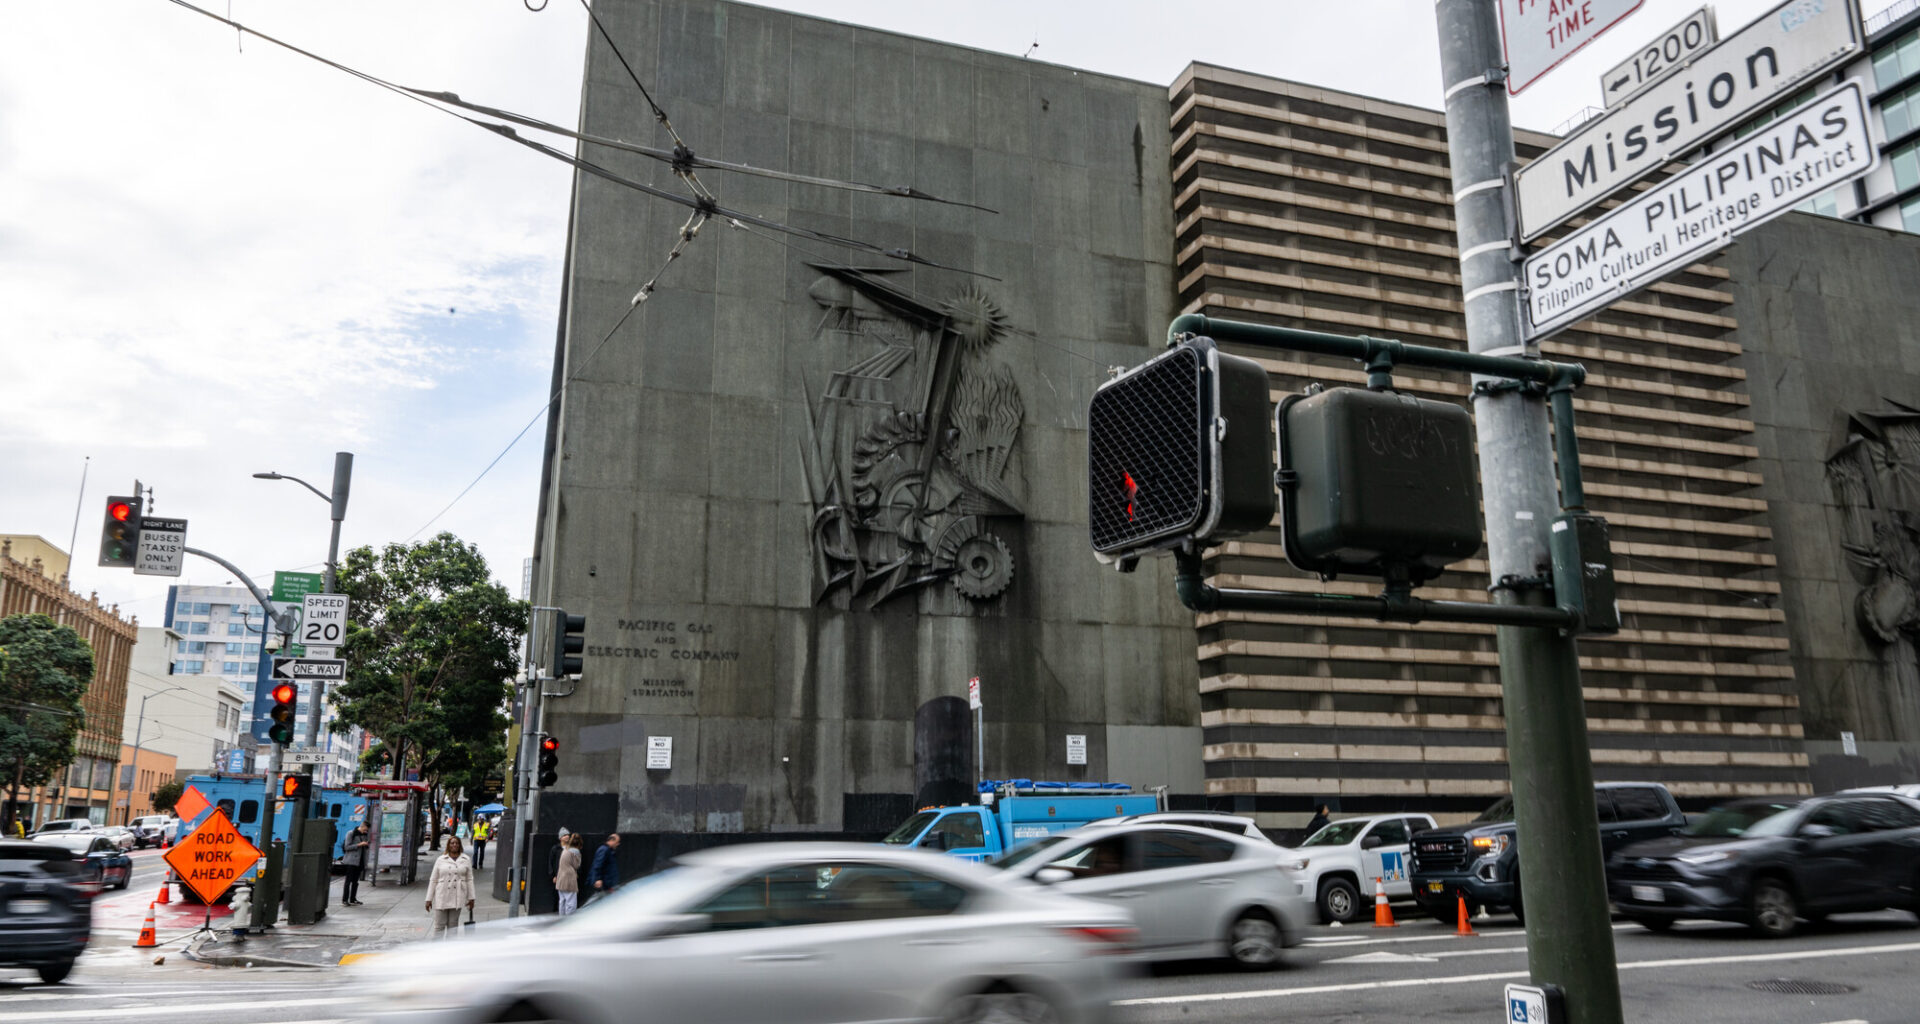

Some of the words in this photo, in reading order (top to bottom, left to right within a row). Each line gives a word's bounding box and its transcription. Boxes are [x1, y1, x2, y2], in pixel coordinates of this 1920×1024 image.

[1545, 0, 1594, 50] TIME
[1633, 20, 1702, 84] 1200
[1562, 46, 1779, 198] Mission
[1535, 227, 1624, 290] SOMA
[1644, 105, 1849, 233] PILIPINAS
[1537, 274, 1594, 316] Filipino
[1599, 233, 1669, 283] Cultural
[1676, 190, 1762, 246] Heritage
[1770, 140, 1858, 199] District
[143, 520, 163, 528] RIGHT
[165, 522, 185, 530] LANE
[144, 533, 180, 543] BUSES
[145, 543, 177, 553] TAXIS
[144, 553, 174, 563] ONLY
[307, 598, 345, 608] SPEED
[310, 610, 340, 619] LIMIT
[305, 622, 340, 641] 20
[617, 618, 677, 632] PACIFIC
[687, 622, 714, 634] GAS
[654, 636, 677, 645] AND
[587, 645, 659, 659] ELECTRIC
[670, 649, 740, 662] COMPANY
[292, 664, 314, 674] ONE
[317, 665, 339, 675] WAY
[642, 678, 686, 687] MISSION
[632, 688, 695, 698] SUBSTATION
[295, 754, 310, 762] 8th
[314, 754, 325, 762] St
[196, 832, 236, 845] ROAD
[194, 850, 233, 863] WORK
[190, 868, 235, 881] AHEAD
